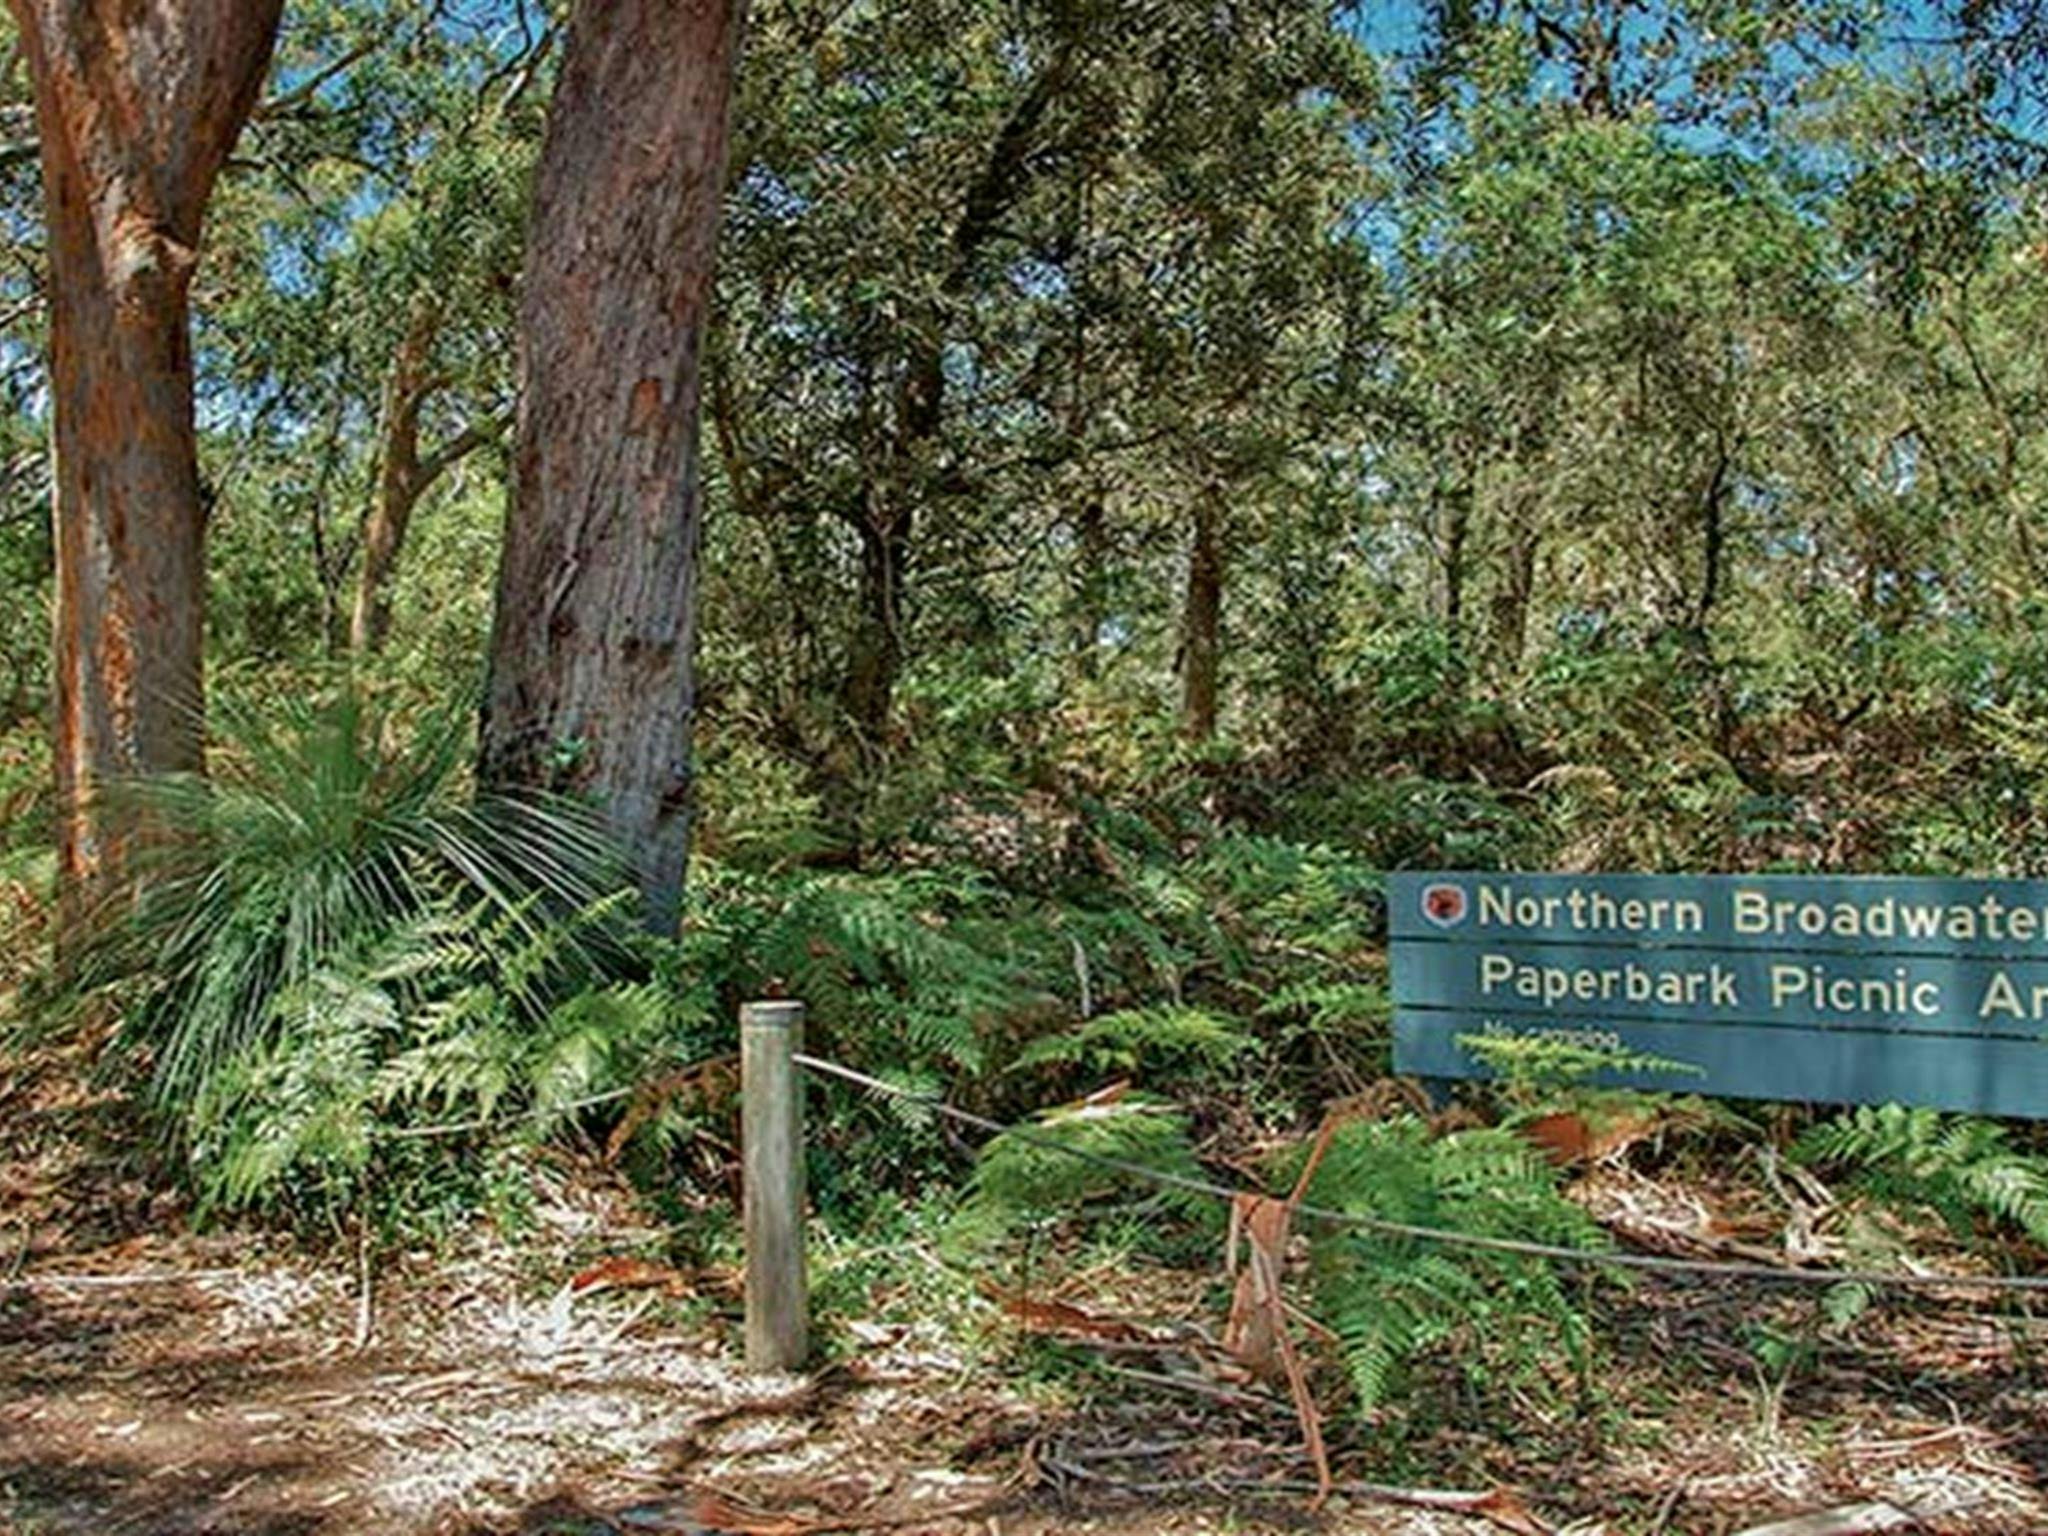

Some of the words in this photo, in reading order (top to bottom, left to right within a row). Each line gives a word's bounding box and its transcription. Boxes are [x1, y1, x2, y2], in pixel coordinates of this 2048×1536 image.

[1478, 885, 1703, 931] Northern
[1481, 954, 1738, 1008] Paperbark
[1770, 964, 1940, 1016] Picnic
